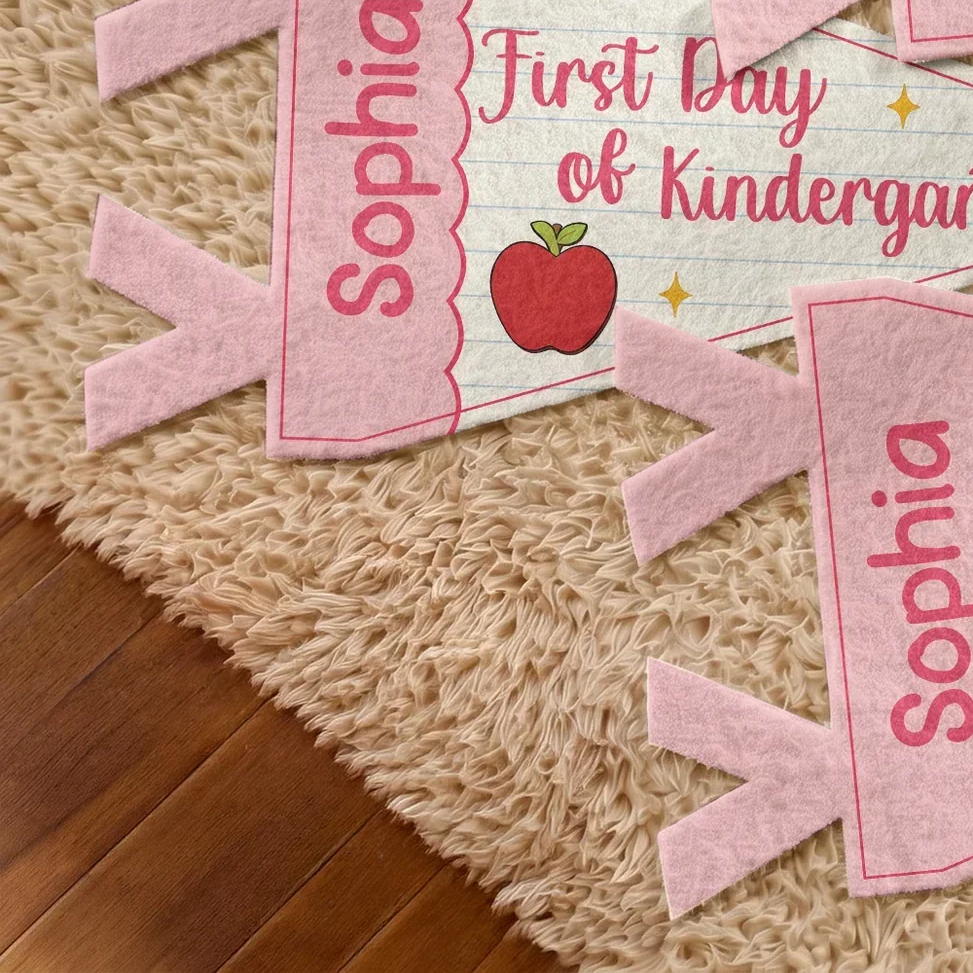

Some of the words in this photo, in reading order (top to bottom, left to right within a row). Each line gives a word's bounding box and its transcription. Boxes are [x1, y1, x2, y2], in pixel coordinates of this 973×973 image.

[479, 28, 657, 124] First
[682, 38, 828, 147] Day
[557, 128, 636, 204] of
